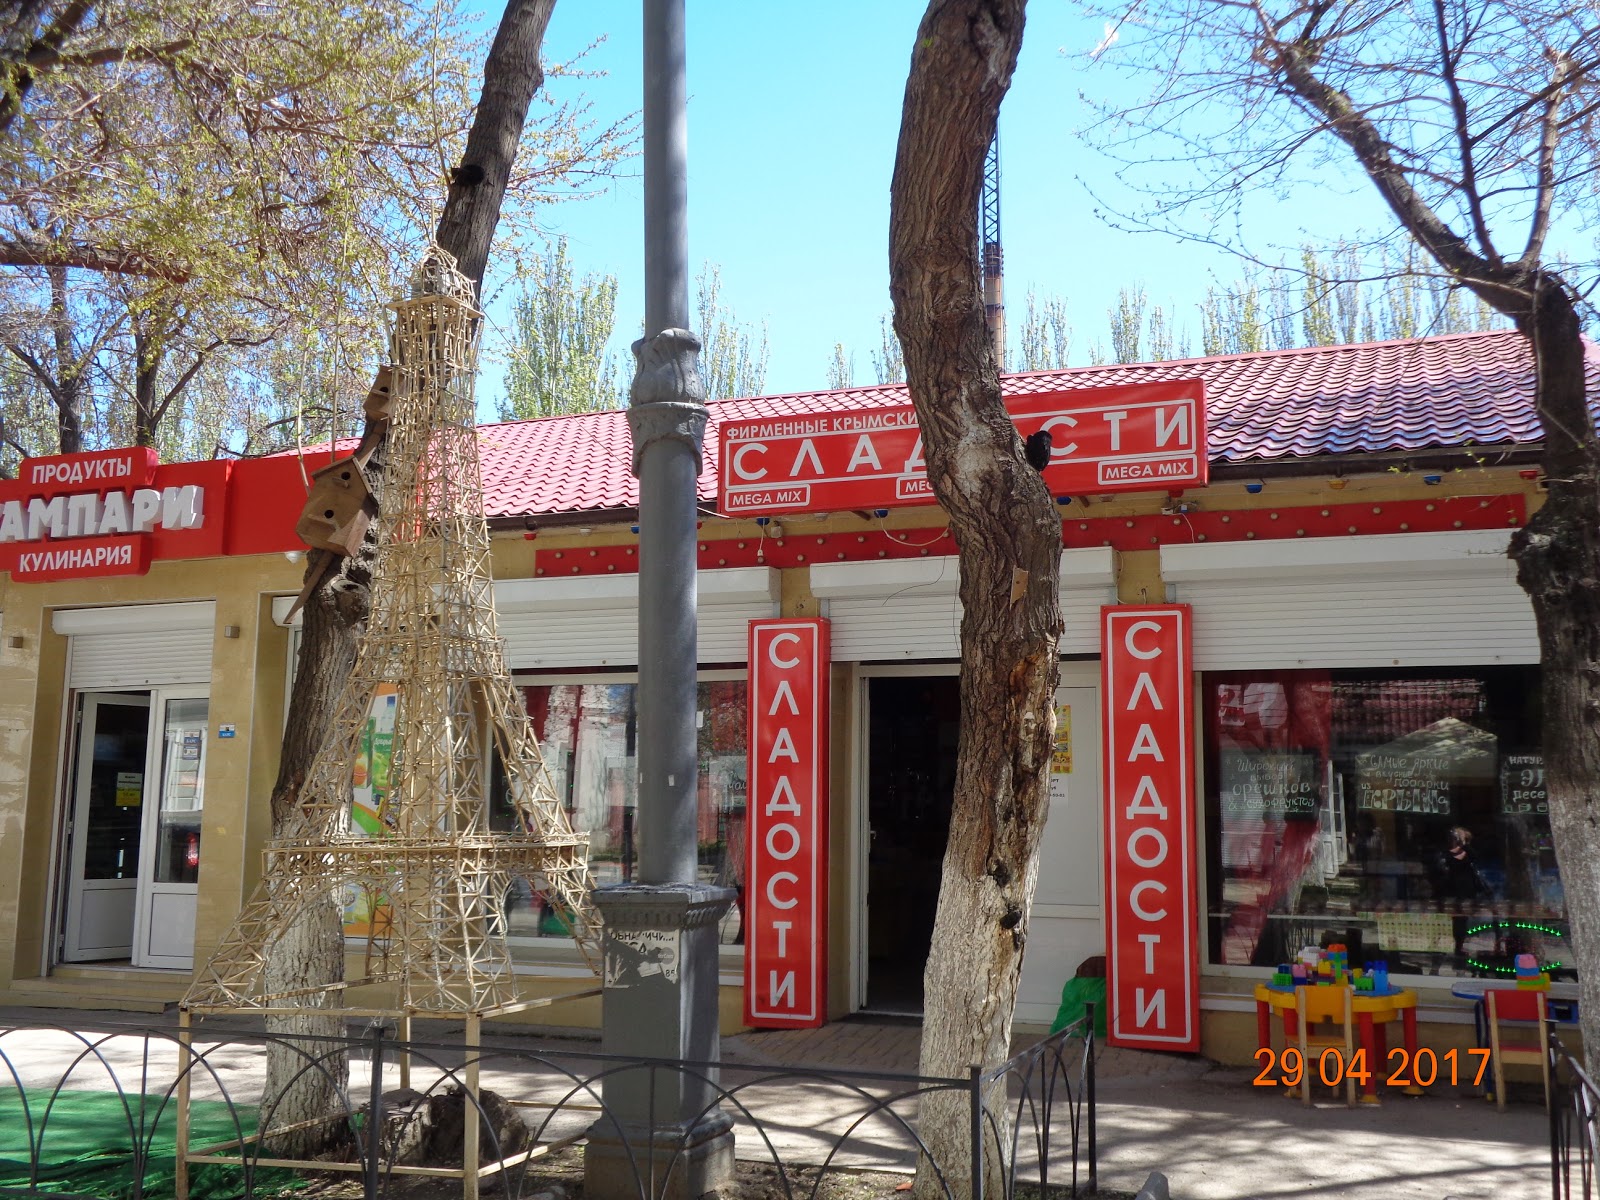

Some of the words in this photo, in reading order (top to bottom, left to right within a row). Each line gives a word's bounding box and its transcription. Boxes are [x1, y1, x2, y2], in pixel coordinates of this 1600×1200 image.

[727, 419, 828, 440] ФИРМЕННЫЕ
[833, 411, 920, 432] КРЫМСКИ
[733, 406, 1188, 481] СЛАДСТИ
[32, 457, 132, 484] ПРОДУКТЫ
[1105, 463, 1154, 479] MEGA
[1158, 461, 1188, 475] MIX
[732, 492, 773, 506] MEGA
[776, 490, 802, 503] MIX
[905, 480, 934, 493] MEG
[0, 485, 205, 542] АМПАРИ
[19, 545, 132, 573] КУЛИНАРИЯ
[1509, 756, 1544, 765] НАТУР
[765, 632, 802, 1009] СЛАДОСТИ
[1124, 620, 1169, 1030] СЛАДОСТИ
